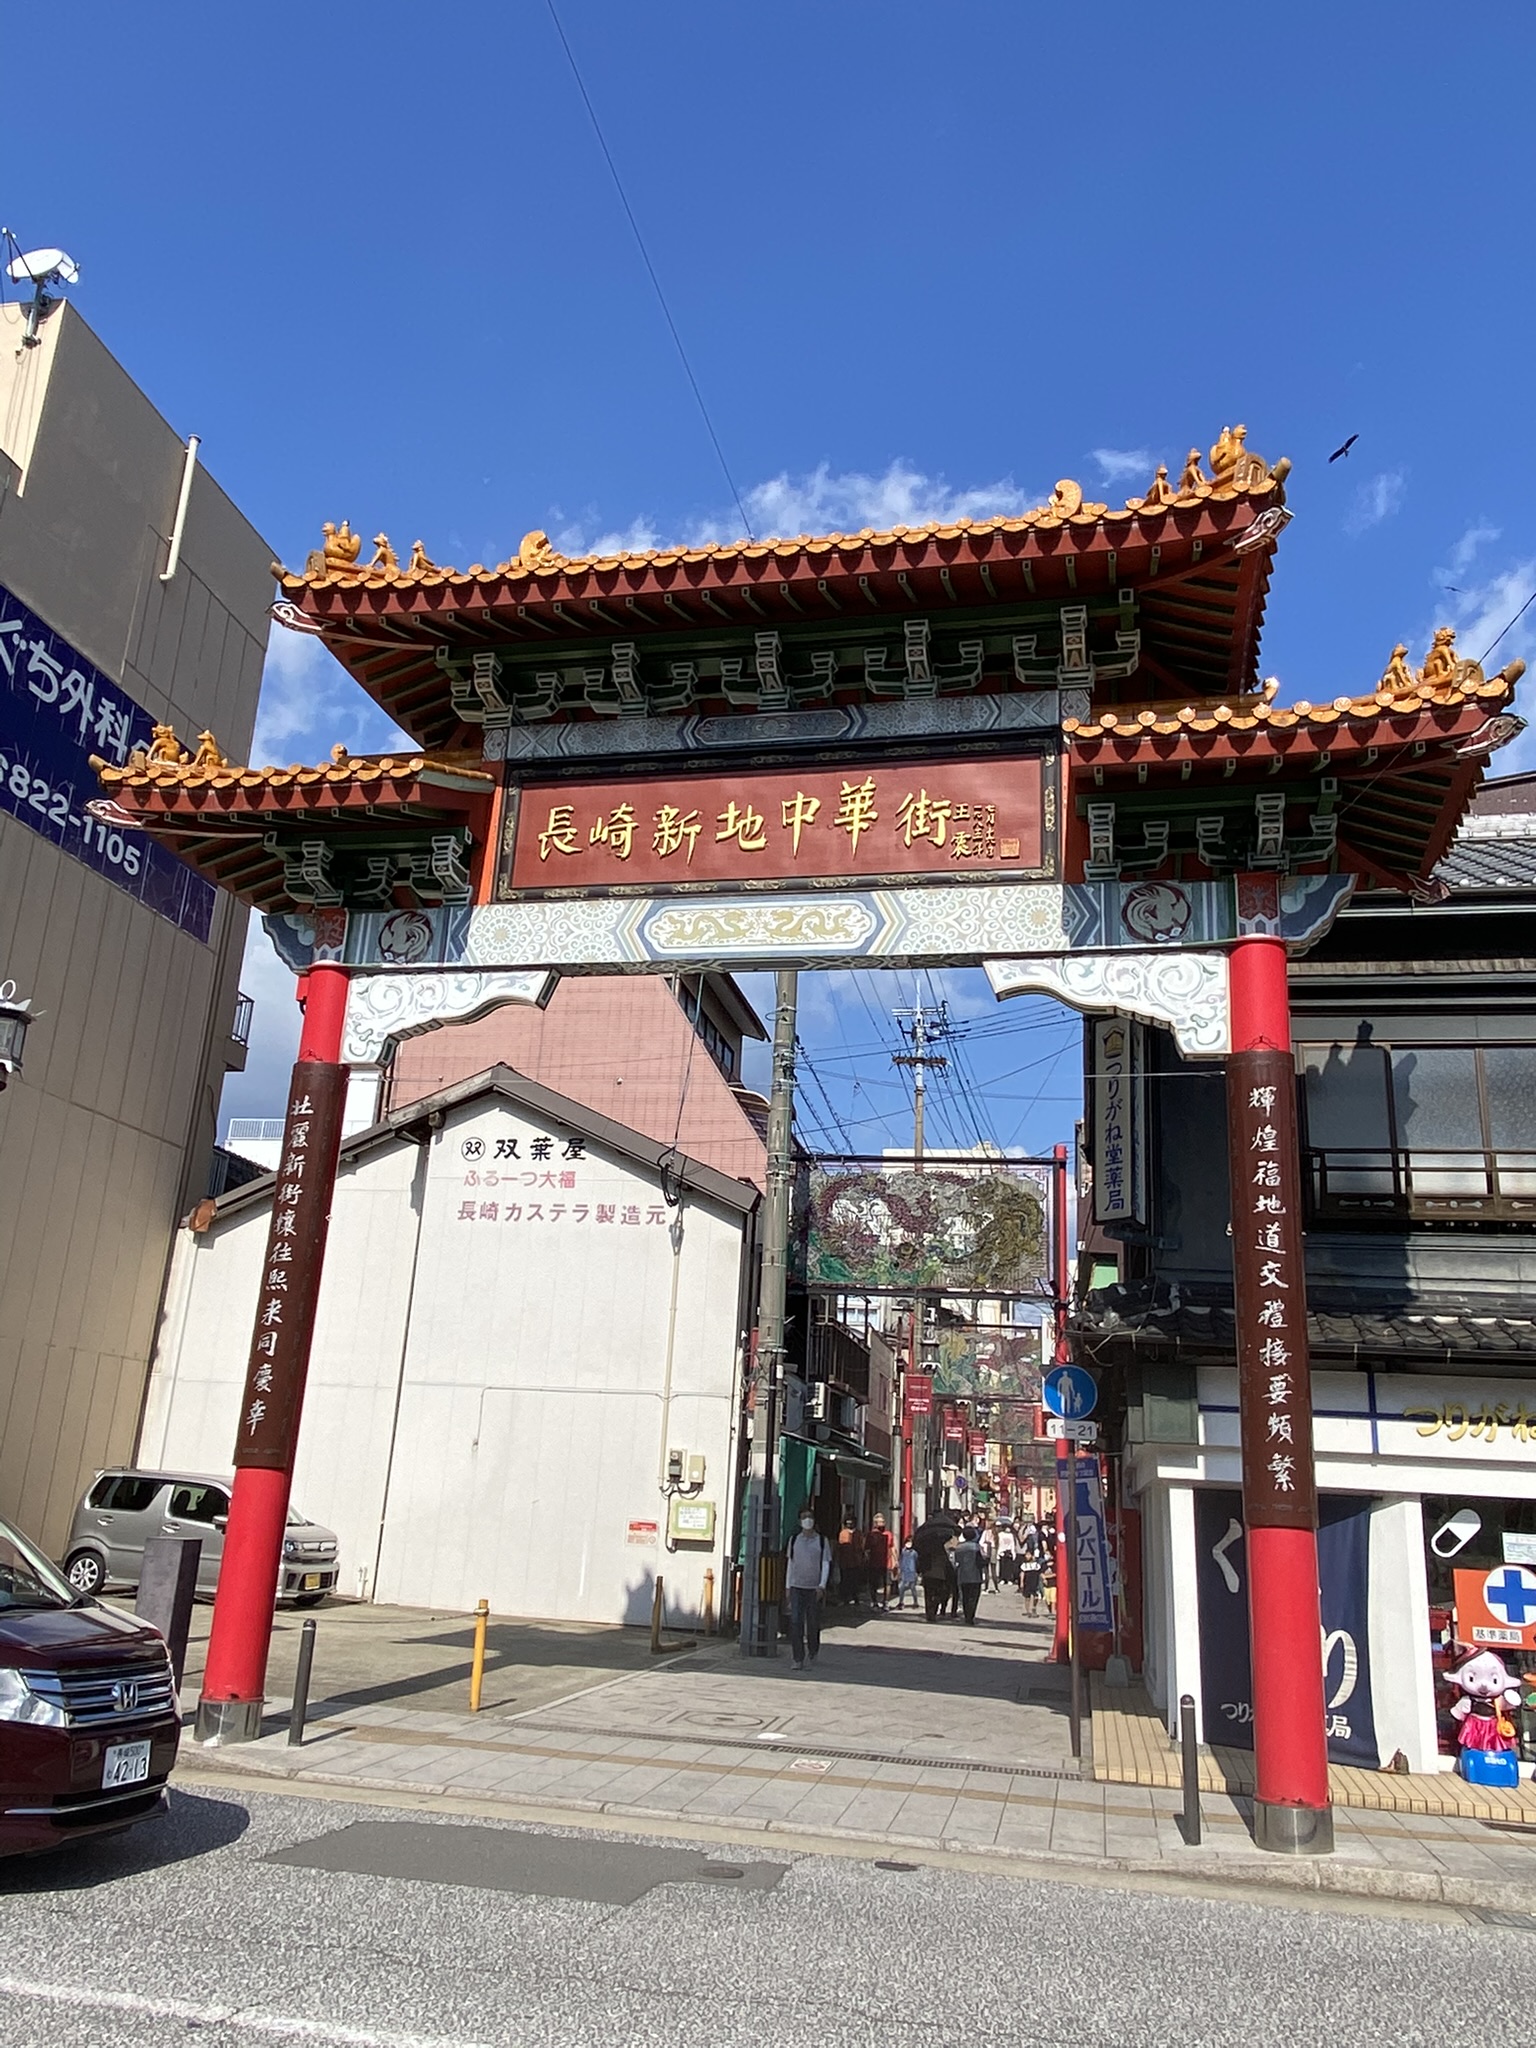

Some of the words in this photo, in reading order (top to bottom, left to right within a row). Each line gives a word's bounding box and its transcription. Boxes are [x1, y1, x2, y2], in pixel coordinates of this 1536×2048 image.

[0, 618, 150, 763] ぐち外科
[537, 775, 953, 866] 長崎新地中華街
[493, 1136, 587, 1161] 双葉屋
[1104, 1062, 1125, 1212] つりがね堂薬局
[463, 1170, 577, 1189] ふるーつ大福
[457, 1201, 667, 1226] 長崎カステラ製造元
[1050, 1424, 1094, 1437] 11-21
